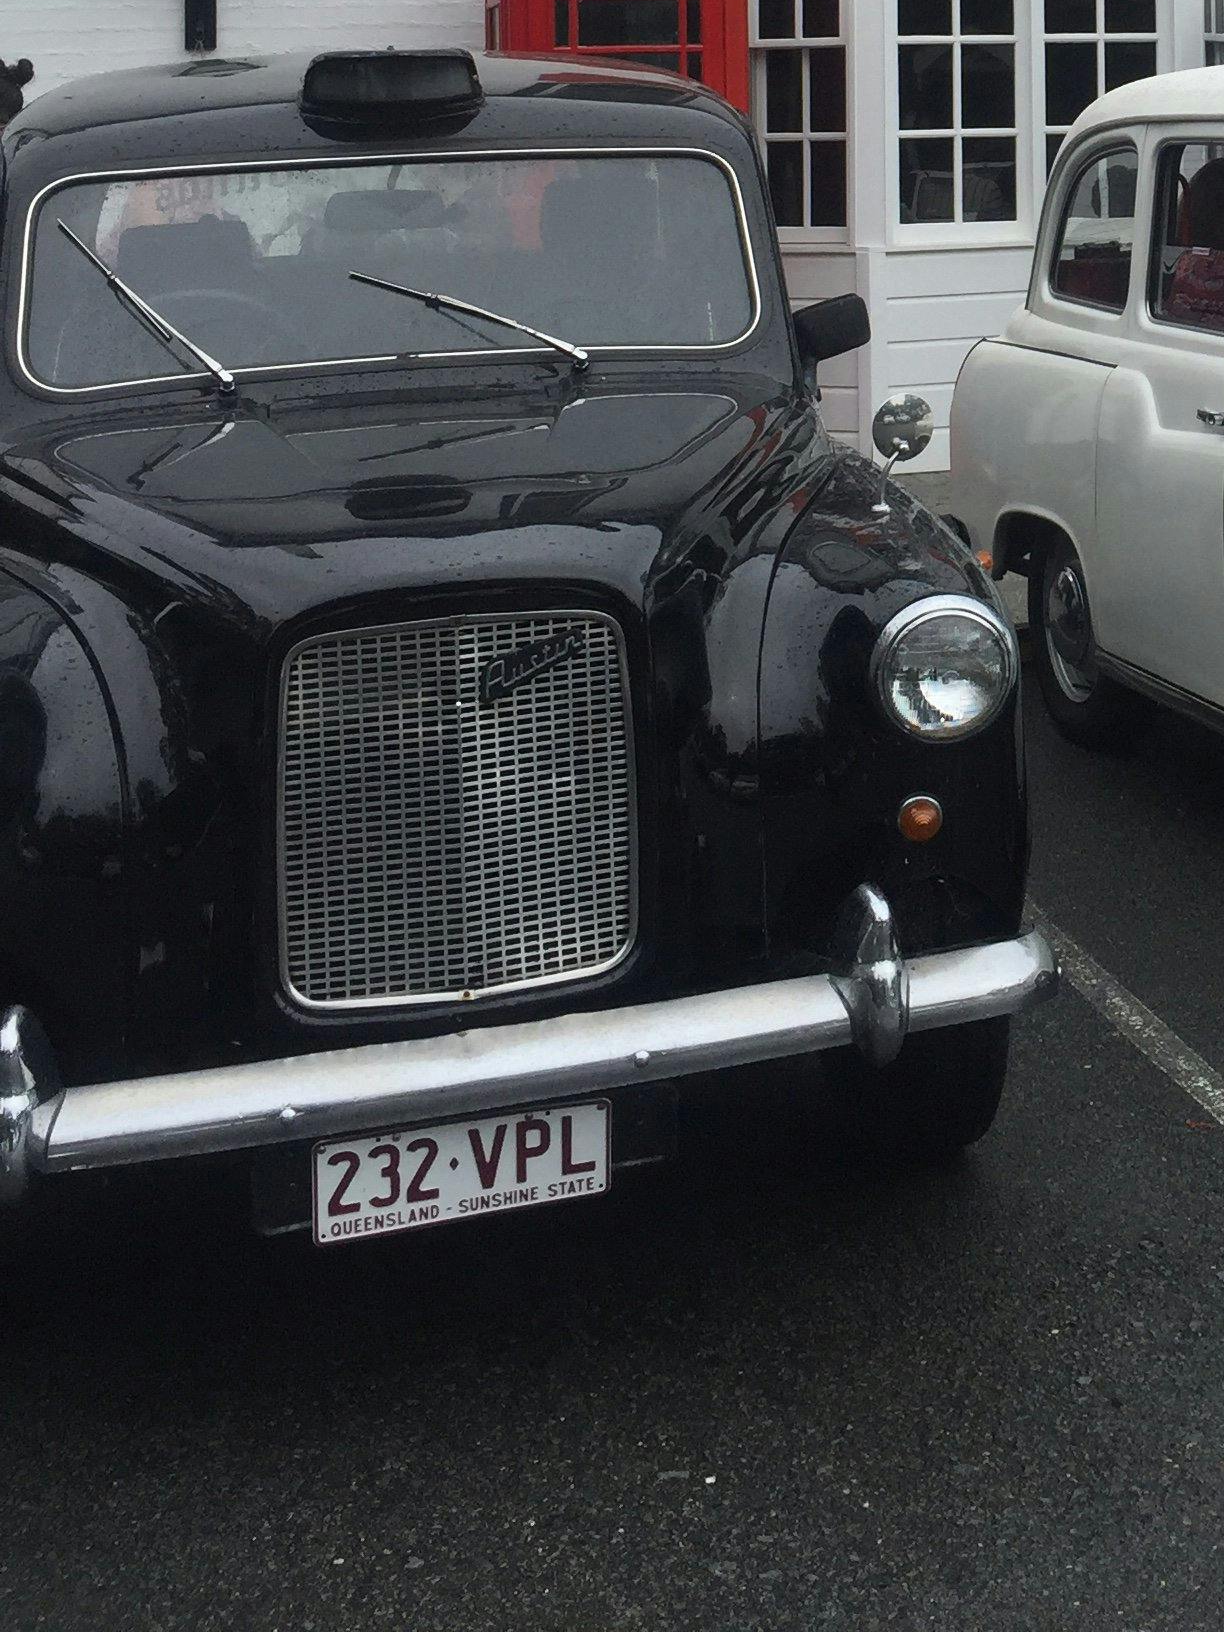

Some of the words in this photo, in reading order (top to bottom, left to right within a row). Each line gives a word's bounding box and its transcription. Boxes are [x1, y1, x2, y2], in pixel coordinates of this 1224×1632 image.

[330, 1205, 440, 1238] QUEENSLAND
[458, 1186, 539, 1214] SUNSHINE
[547, 1176, 595, 1198] STATE
